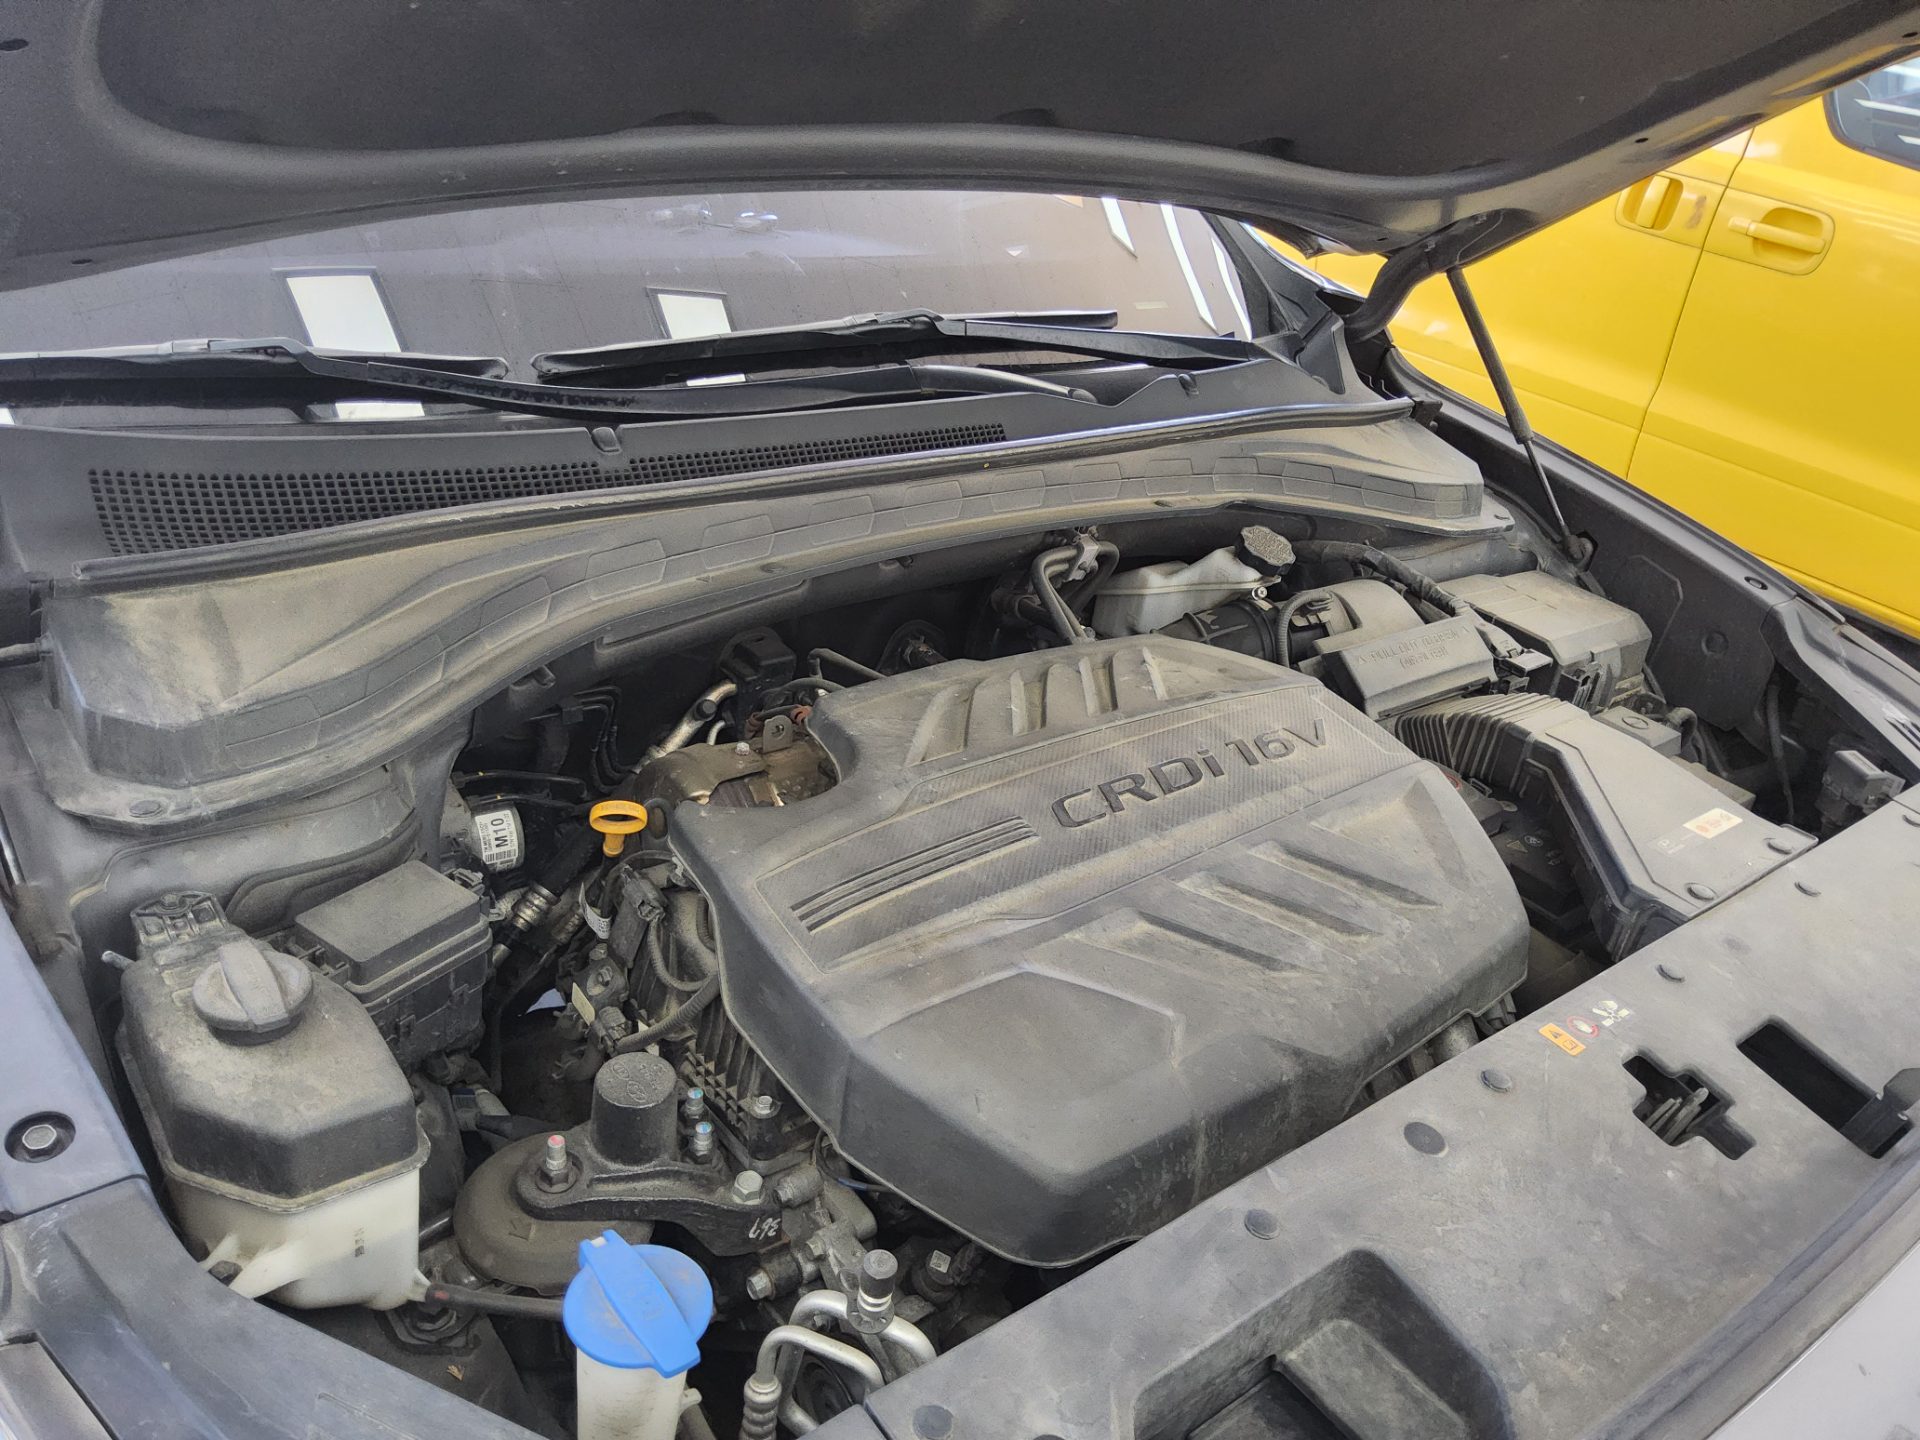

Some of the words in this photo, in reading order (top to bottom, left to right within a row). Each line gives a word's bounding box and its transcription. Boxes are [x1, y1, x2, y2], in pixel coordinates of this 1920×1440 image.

[1051, 748, 1225, 828] CRDi
[1224, 718, 1327, 767] 16V
[491, 818, 509, 848] M10
